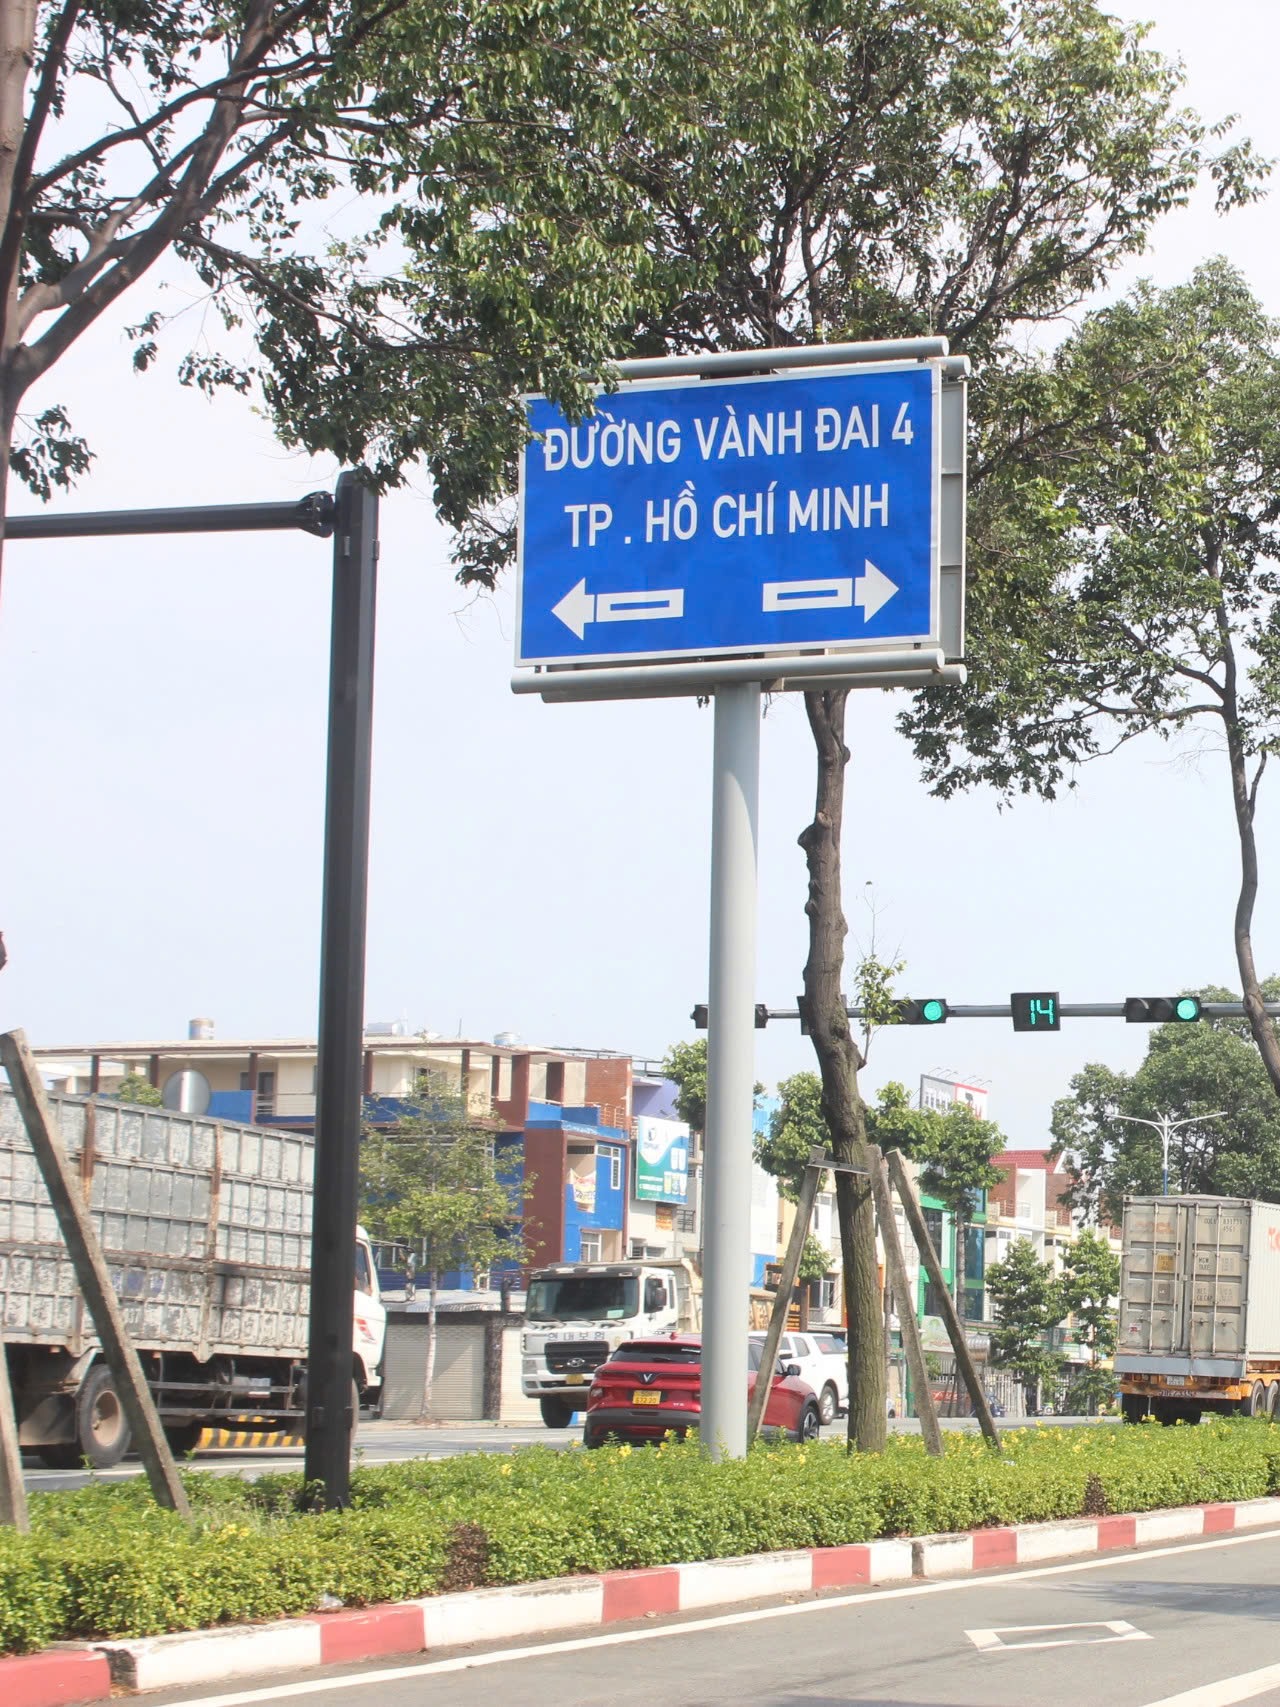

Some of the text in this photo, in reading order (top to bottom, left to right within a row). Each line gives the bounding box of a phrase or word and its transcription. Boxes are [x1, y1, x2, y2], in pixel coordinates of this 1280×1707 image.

[542, 402, 914, 471] ĐƯỜNG VÀNH ĐAI 4
[645, 480, 698, 543] HỒ
[713, 481, 778, 539] CHÍ
[788, 483, 889, 534] MINH
[1030, 999, 1054, 1025] 14
